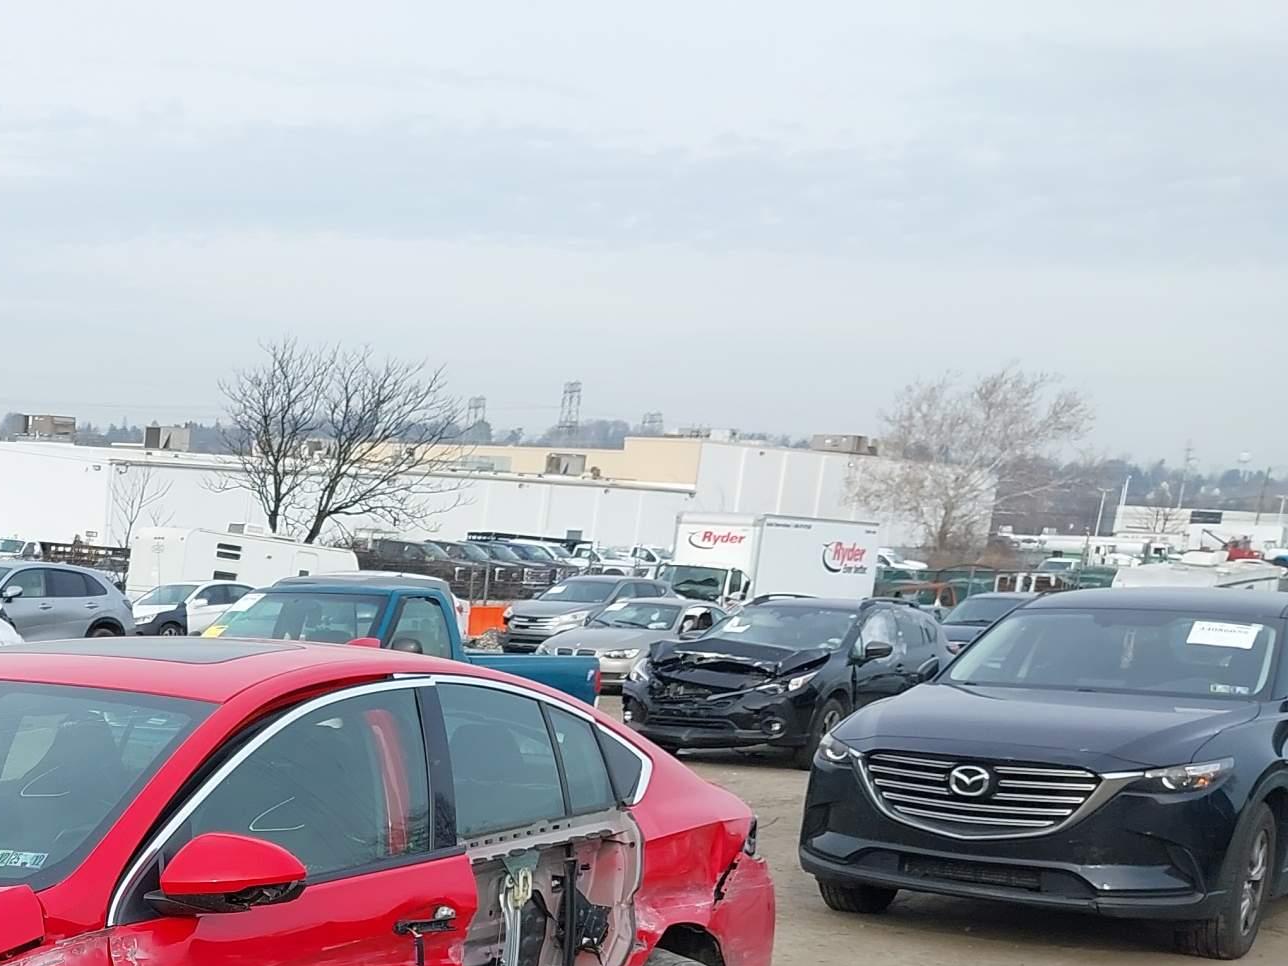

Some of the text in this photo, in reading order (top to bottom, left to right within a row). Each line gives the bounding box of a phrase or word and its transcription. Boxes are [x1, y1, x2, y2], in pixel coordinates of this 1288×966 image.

[701, 530, 746, 545] Ryder
[832, 541, 866, 566] Ryder
[9, 852, 23, 865] 25
